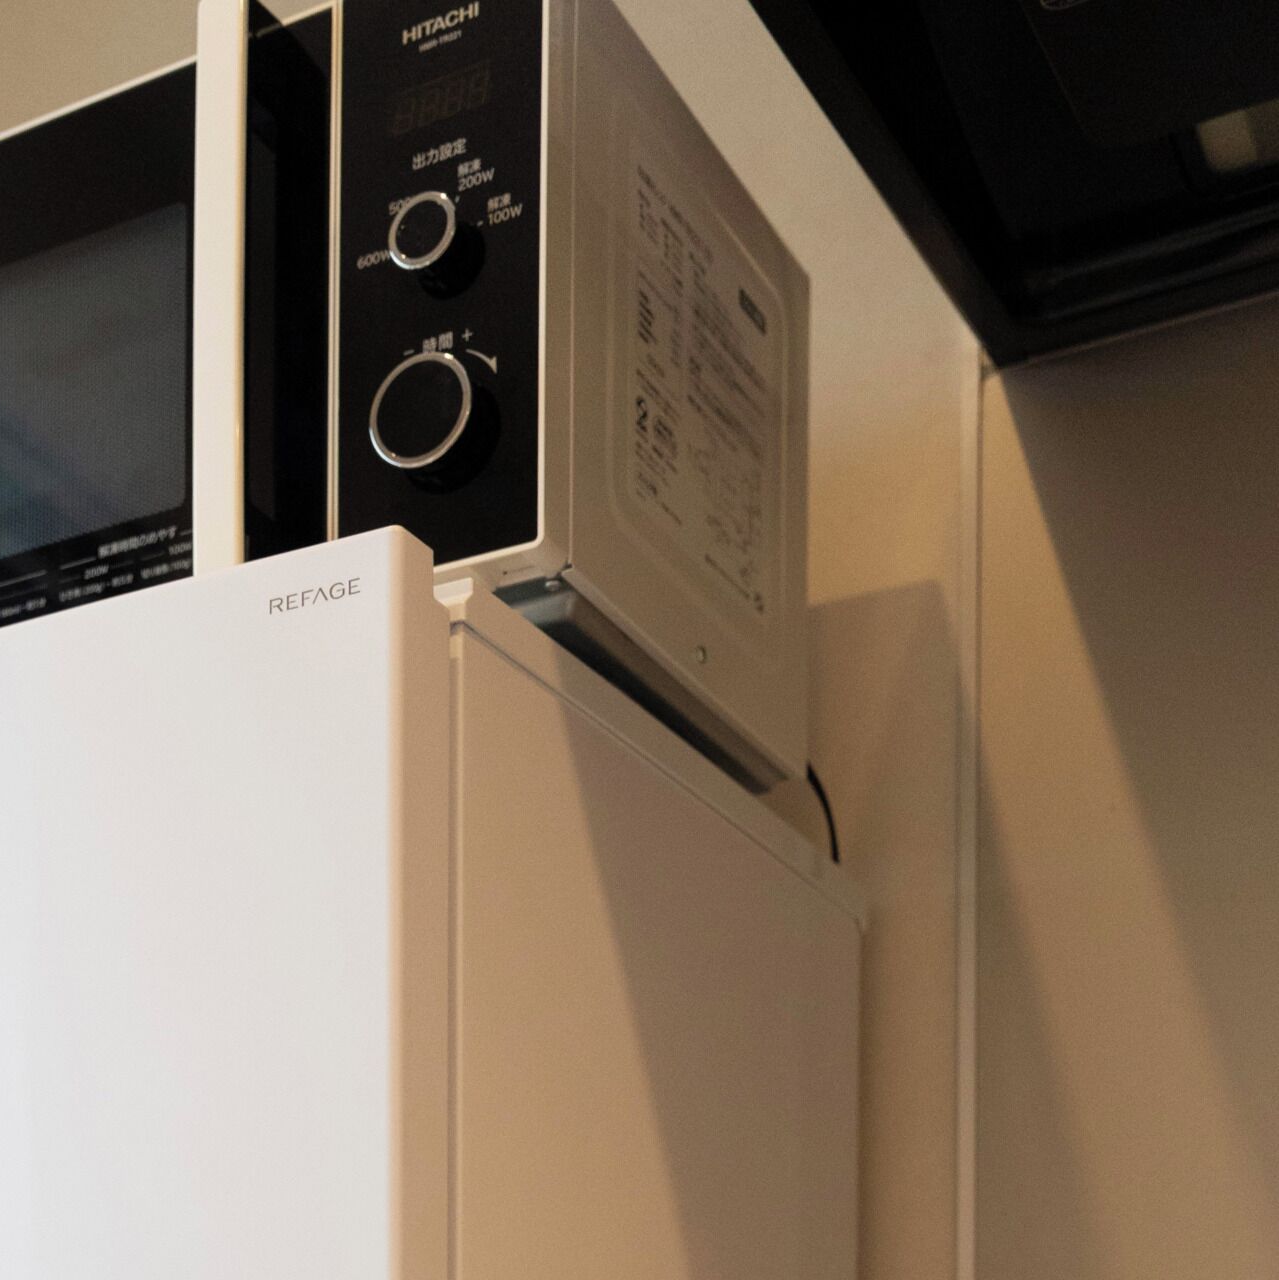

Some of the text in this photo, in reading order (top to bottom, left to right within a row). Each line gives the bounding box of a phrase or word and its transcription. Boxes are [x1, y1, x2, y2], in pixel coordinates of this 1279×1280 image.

[402, 1, 480, 45] HITACHI
[412, 138, 467, 170] 出力設定
[458, 167, 495, 191] 200W
[488, 203, 523, 225] 100W
[269, 577, 360, 615] REFAGE
